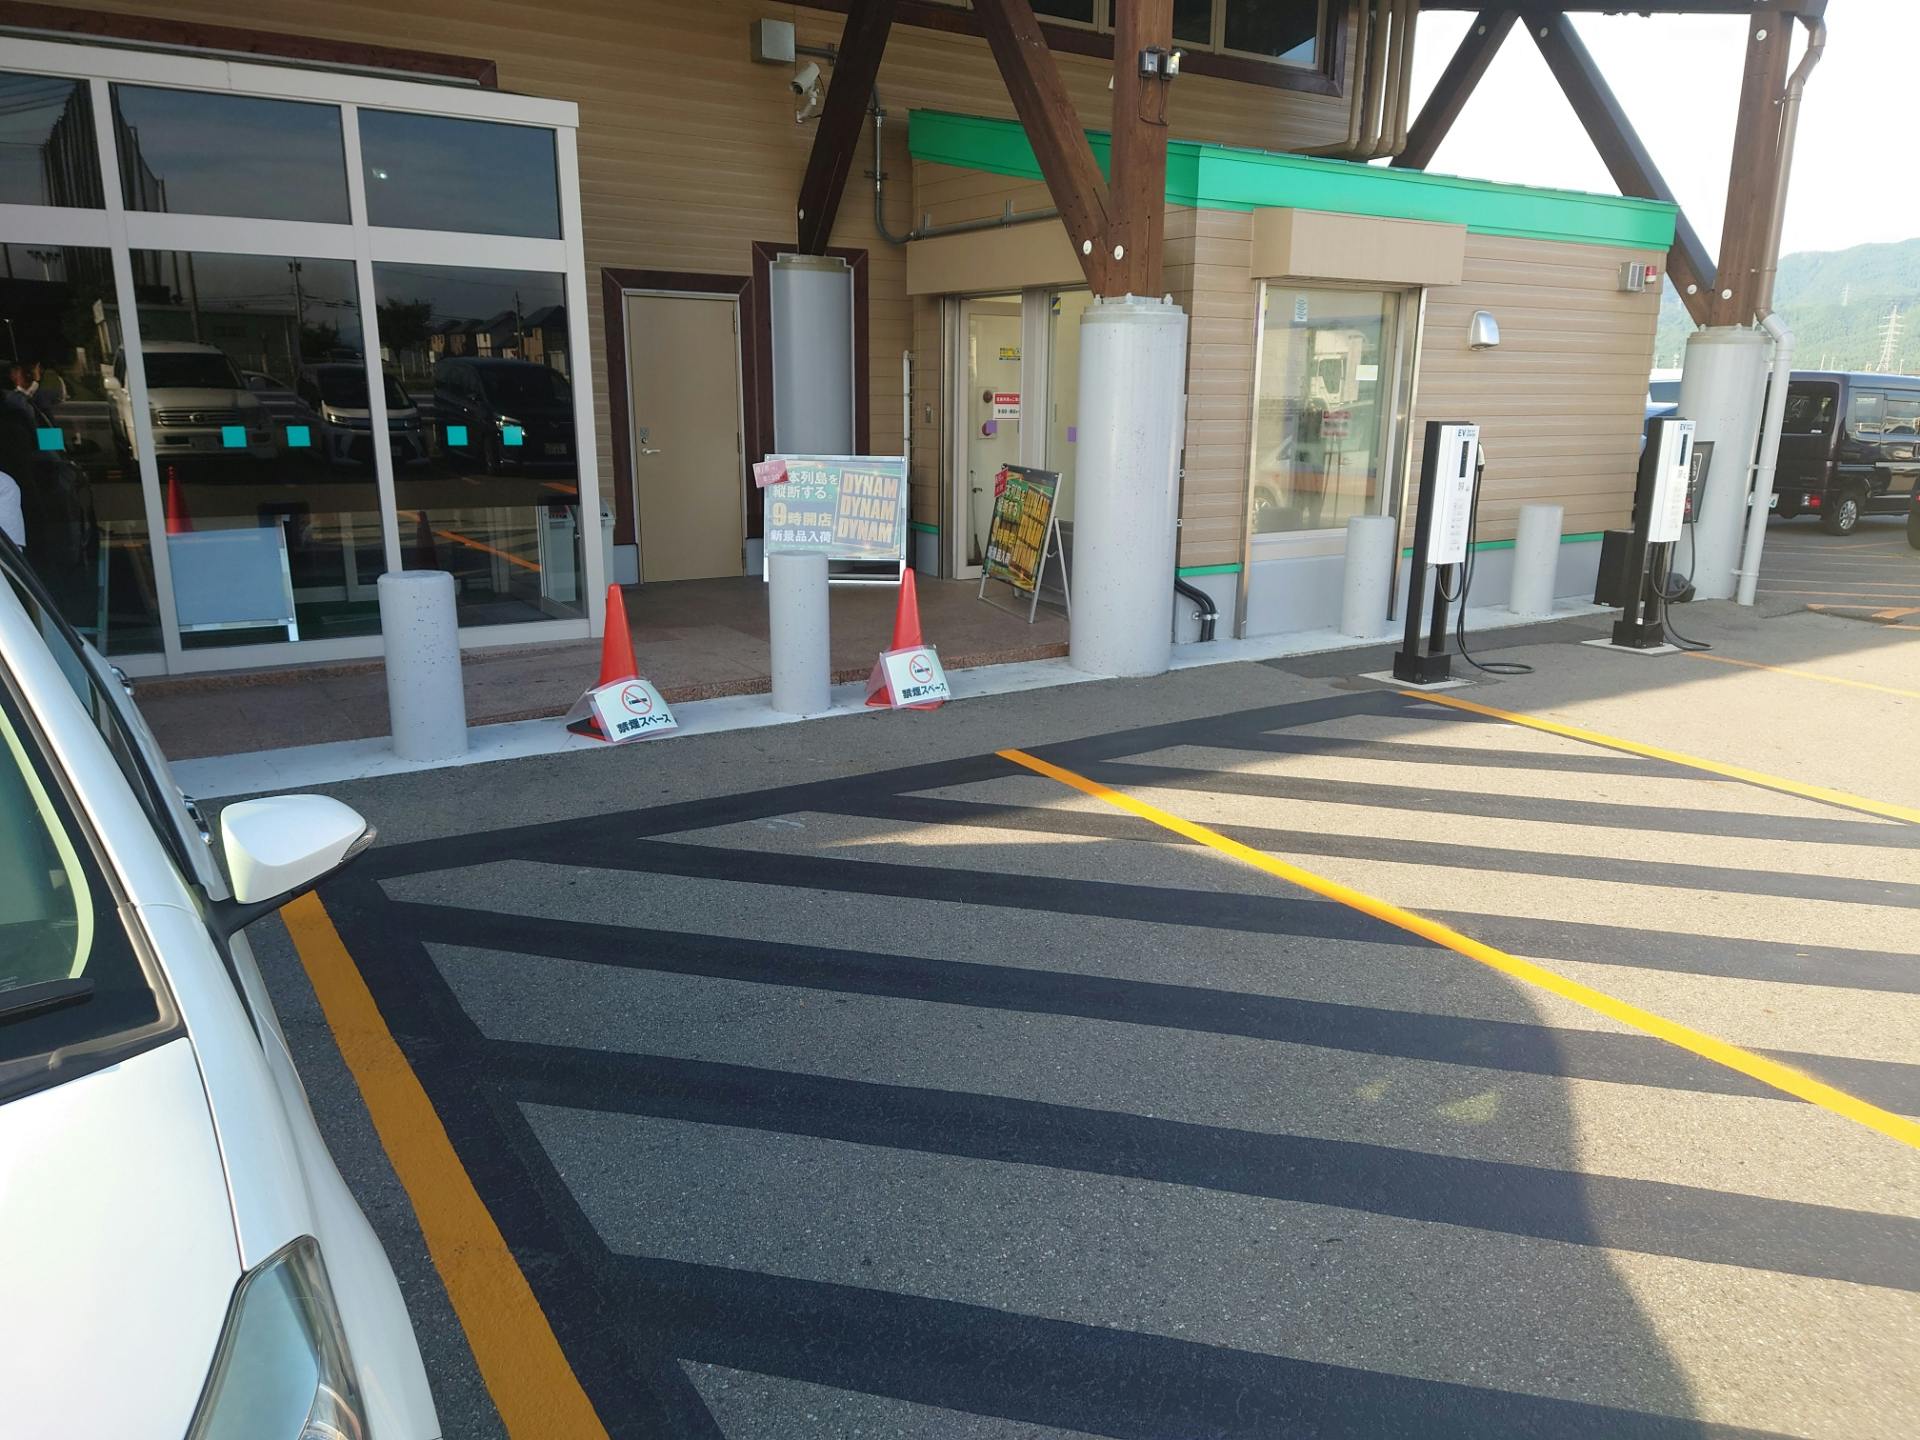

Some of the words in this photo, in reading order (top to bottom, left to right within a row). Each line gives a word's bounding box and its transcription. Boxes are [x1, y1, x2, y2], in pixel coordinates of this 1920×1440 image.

[788, 470, 840, 485] 本列島を
[843, 471, 898, 498] DYNAM
[772, 502, 832, 527] 9時開店
[840, 494, 896, 521] DYNAM
[770, 529, 832, 543] 新景品入荷
[837, 517, 893, 544] DYNAM
[902, 682, 946, 699] 禁煙スペース
[616, 714, 672, 734] 禁煙スペース
